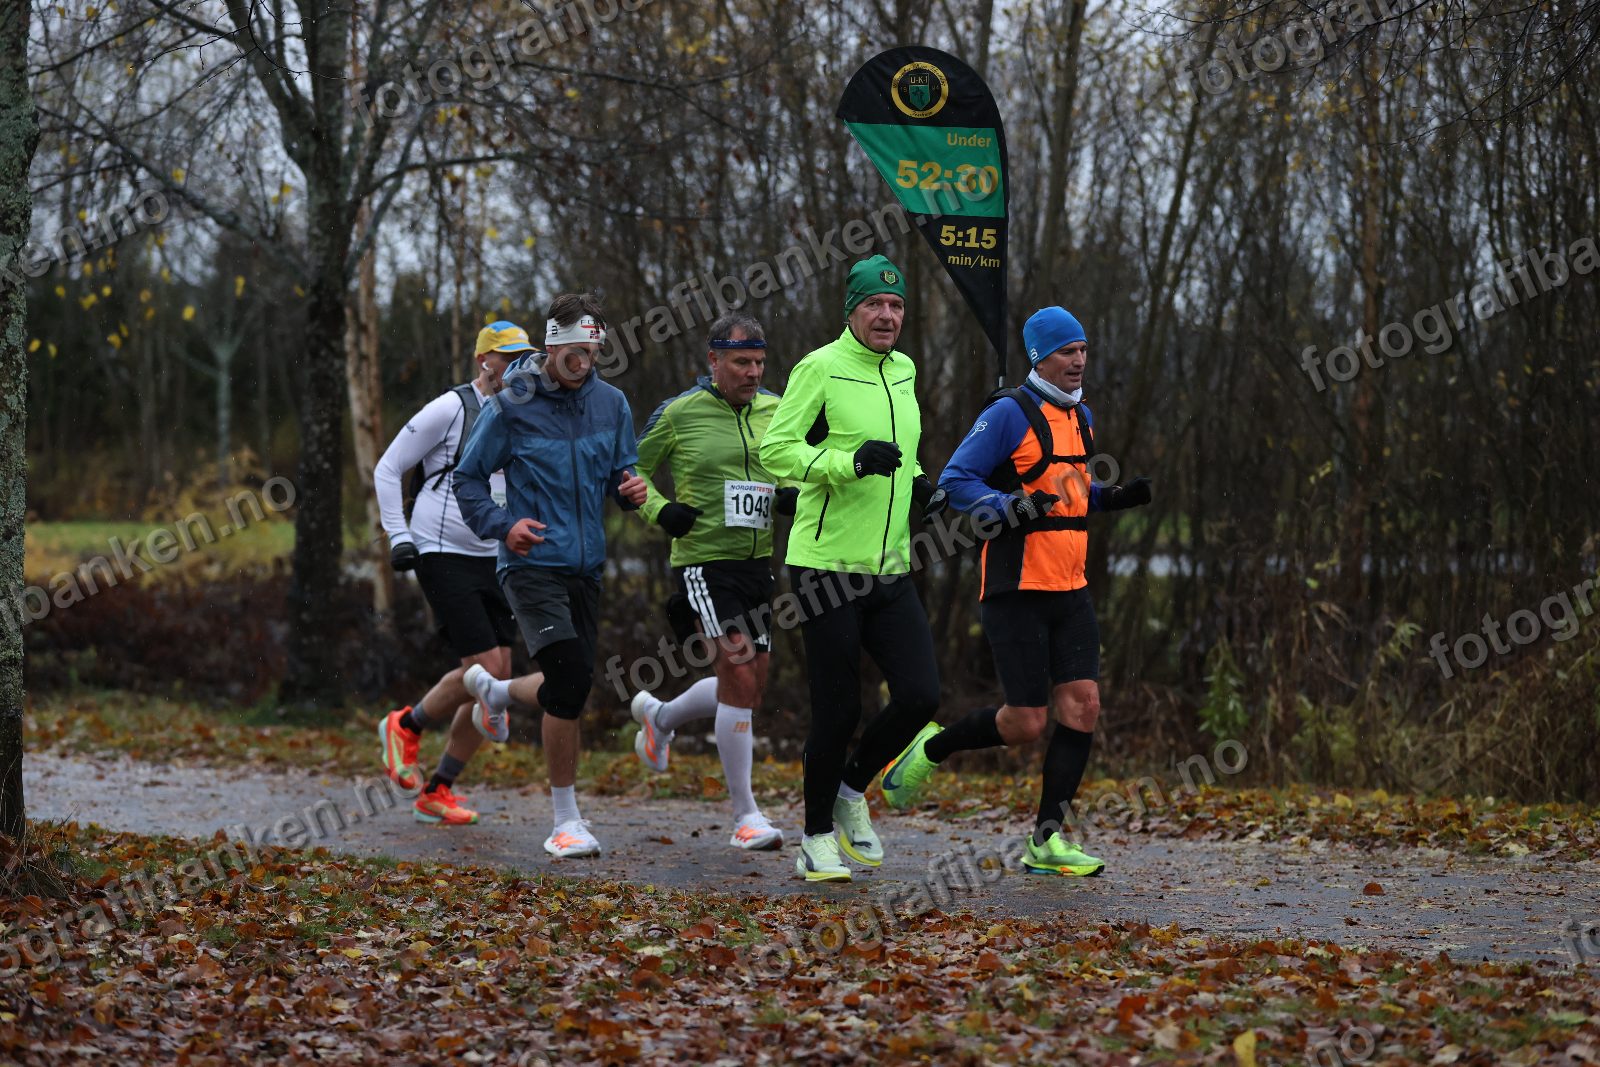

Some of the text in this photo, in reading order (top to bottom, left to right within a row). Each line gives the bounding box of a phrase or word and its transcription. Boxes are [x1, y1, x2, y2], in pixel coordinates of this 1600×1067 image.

[947, 132, 991, 148] Under
[896, 159, 999, 194] 52:30
[940, 225, 997, 249] 5:15
[947, 253, 1000, 269] min/km
[731, 493, 770, 518] 1043
